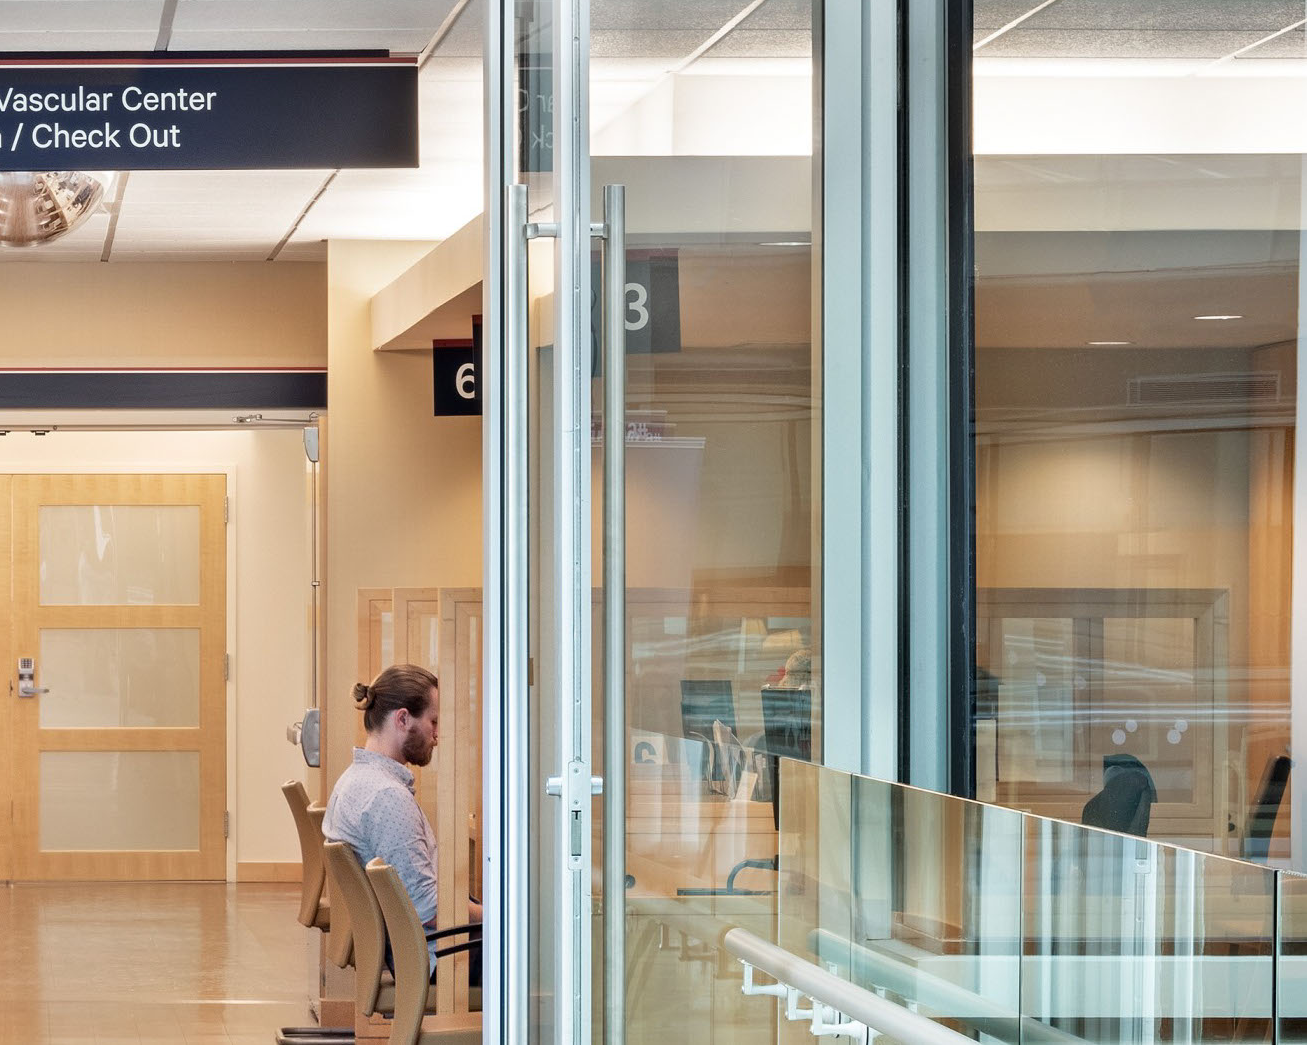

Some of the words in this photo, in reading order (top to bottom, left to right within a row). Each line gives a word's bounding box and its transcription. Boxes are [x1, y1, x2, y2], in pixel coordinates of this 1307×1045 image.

[121, 85, 218, 112] Center
[10, 122, 24, 152] /
[31, 121, 122, 149] Check
[128, 122, 182, 149] Out
[624, 282, 649, 331] 3
[455, 362, 475, 399] 6
